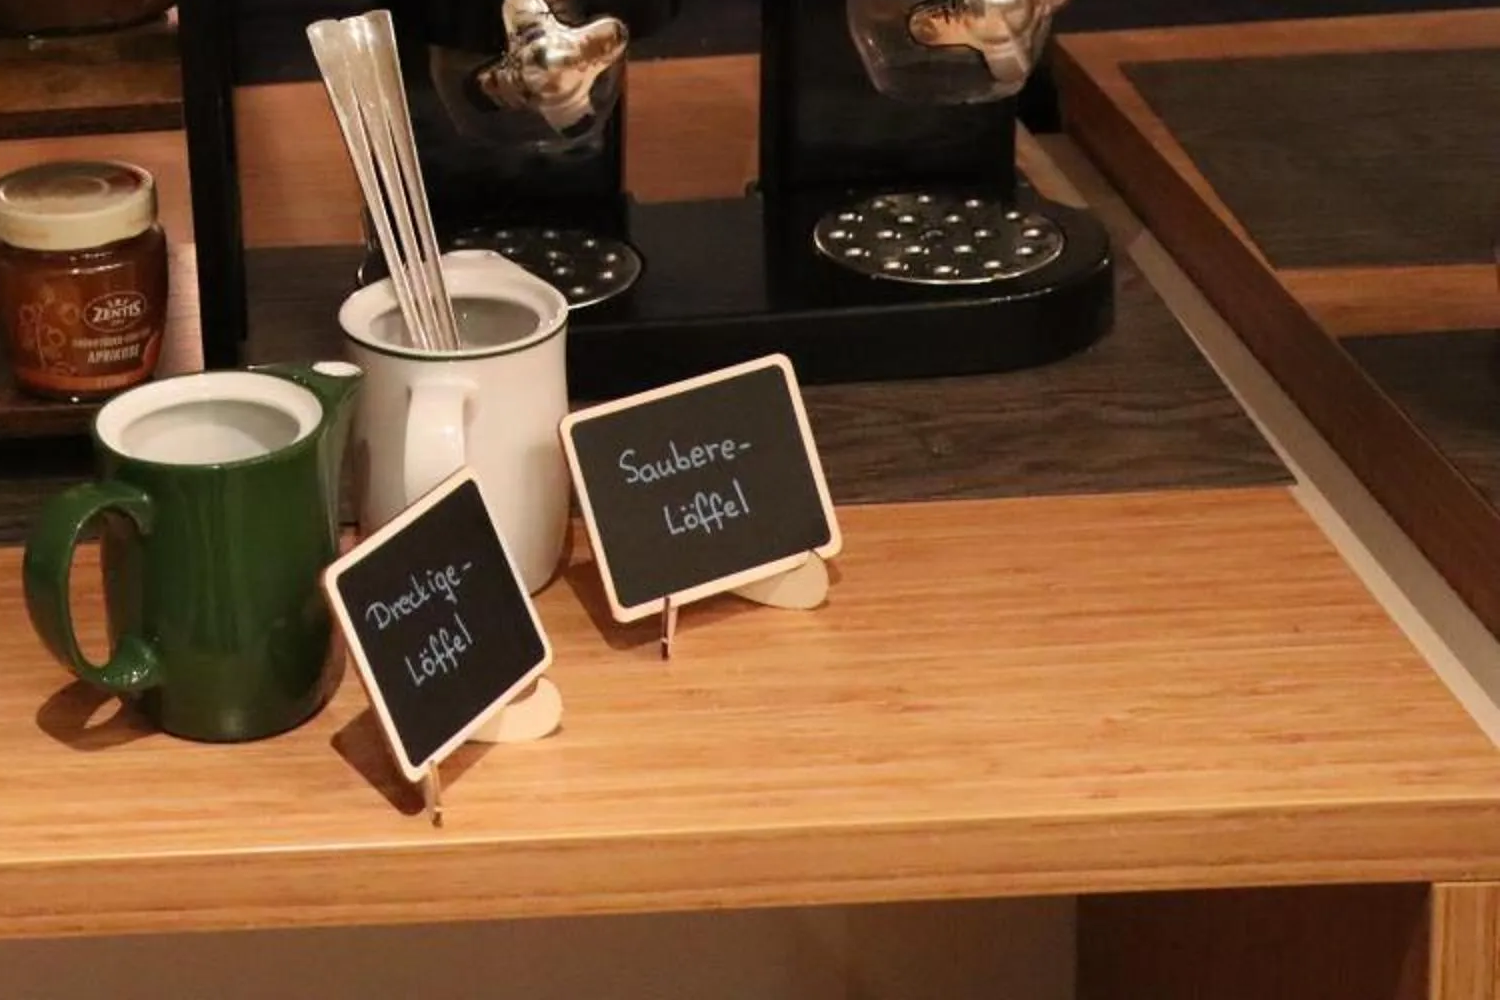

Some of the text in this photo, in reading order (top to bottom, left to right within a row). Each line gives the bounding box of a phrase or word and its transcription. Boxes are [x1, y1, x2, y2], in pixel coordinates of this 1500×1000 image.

[92, 300, 141, 323] ZENTIS
[618, 437, 753, 485] Saubere-
[663, 479, 752, 537] Löffel
[365, 560, 474, 631] Dreckige-
[405, 614, 475, 688] Löffel
